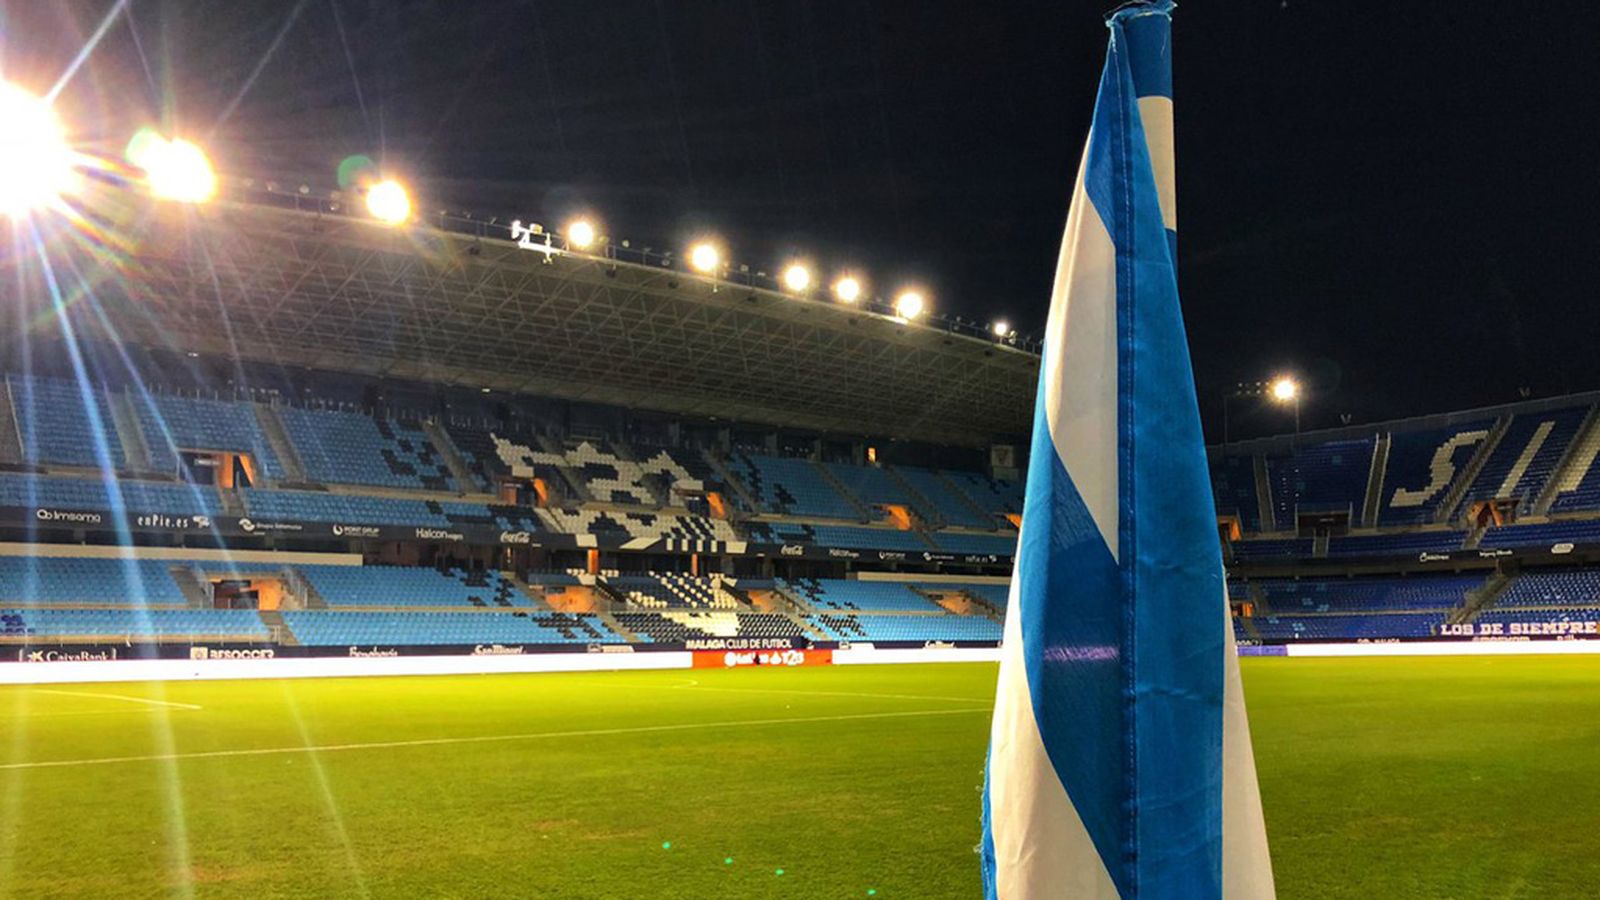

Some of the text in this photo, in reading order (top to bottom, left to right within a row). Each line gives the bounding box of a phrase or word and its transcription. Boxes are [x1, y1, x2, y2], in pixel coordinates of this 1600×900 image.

[1440, 621, 1598, 636] LOS DE SIEMPRE
[726, 638, 749, 649] CLUB
[749, 638, 761, 649] DE
[762, 638, 792, 649] FUTBOL
